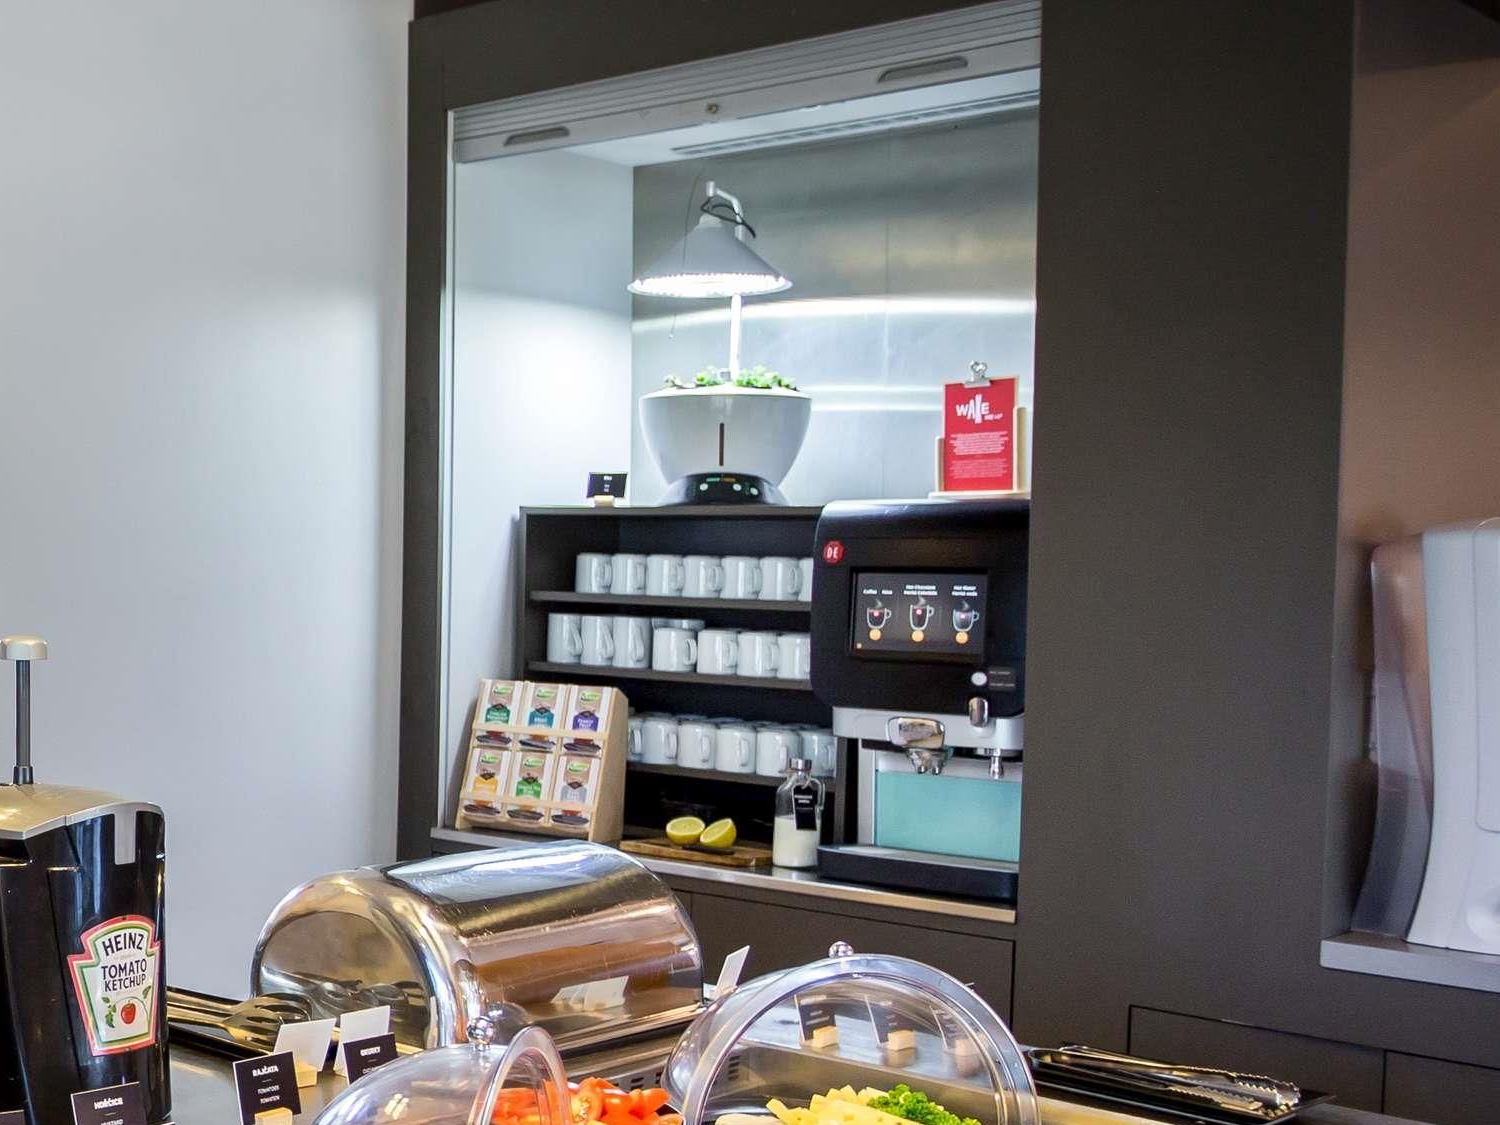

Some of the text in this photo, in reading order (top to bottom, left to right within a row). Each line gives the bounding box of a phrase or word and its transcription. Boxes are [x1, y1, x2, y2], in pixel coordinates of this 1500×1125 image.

[102, 932, 144, 956] HEINZ
[101, 958, 147, 980] TOMATO
[104, 973, 146, 992] KETCHUP
